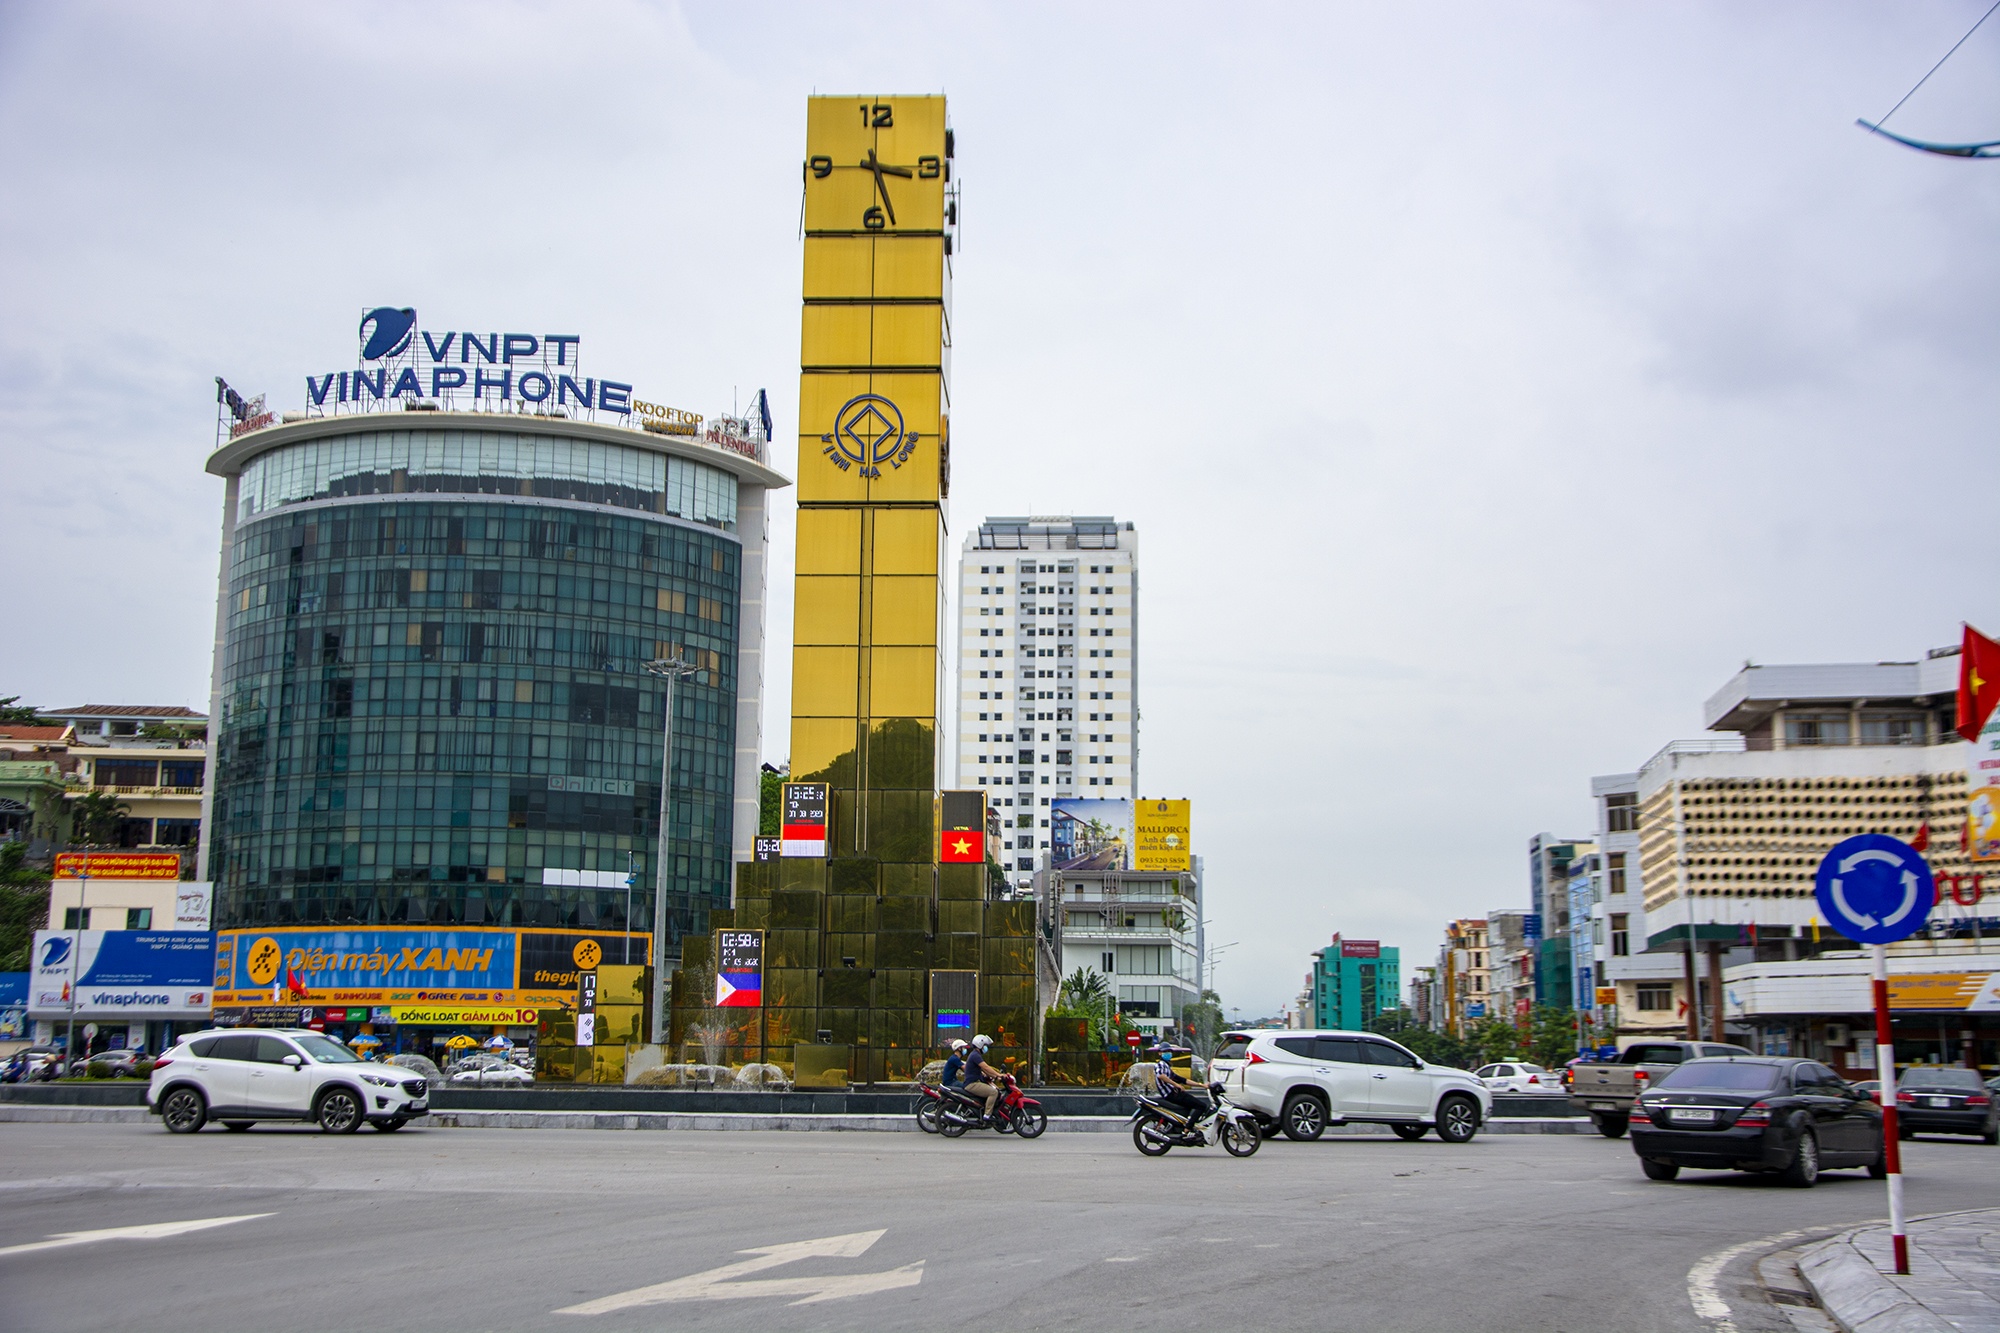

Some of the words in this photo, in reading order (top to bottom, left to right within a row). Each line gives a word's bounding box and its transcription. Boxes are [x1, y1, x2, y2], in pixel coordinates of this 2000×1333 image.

[860, 104, 893, 127] 12
[810, 155, 832, 179] 9
[918, 155, 940, 178] 3
[863, 205, 885, 229] 6
[421, 330, 580, 365] VNPT
[307, 366, 632, 414] VINAPHONE
[633, 399, 703, 426] ROOFTOP
[706, 429, 757, 457] PRUDENTIAL
[860, 466, 881, 480] HẠ
[890, 431, 919, 469] LONG
[1137, 826, 1188, 834] MALLORCA
[93, 992, 170, 1006] vinaphone
[334, 992, 382, 1000] SUNHOUSE
[390, 992, 414, 1000] acer
[427, 992, 457, 1000] GREE
[433, 1013, 459, 1023] LOẠT
[492, 1011, 516, 1021] LỚN
